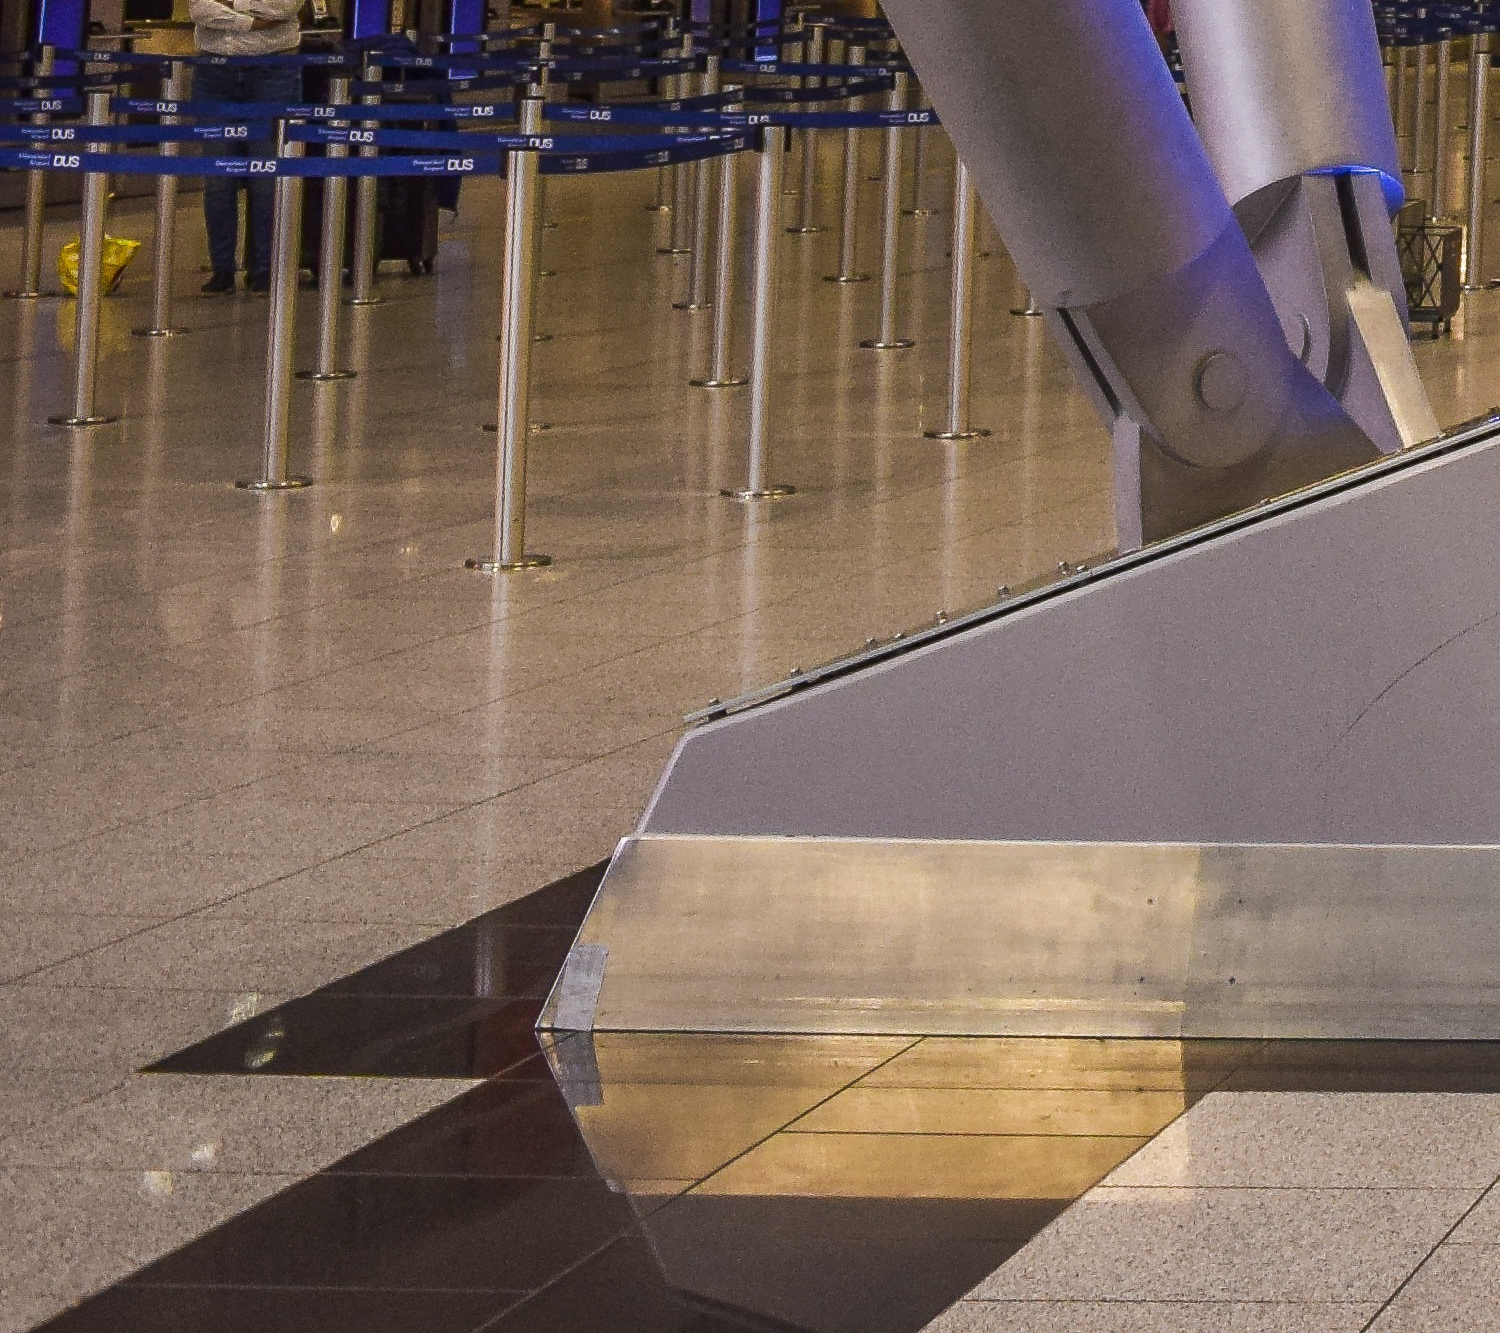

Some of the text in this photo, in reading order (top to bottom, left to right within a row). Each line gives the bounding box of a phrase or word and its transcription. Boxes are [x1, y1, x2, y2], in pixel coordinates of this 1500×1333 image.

[41, 101, 62, 110] DUS
[156, 102, 177, 112] DUS
[472, 106, 494, 116] DUS
[314, 107, 336, 117] DUS
[590, 111, 612, 121] DUS
[52, 128, 75, 140] DUS
[224, 126, 248, 138] DUS
[350, 131, 374, 143] DUS
[53, 155, 80, 168] DUS
[250, 160, 277, 173] DUS
[448, 159, 474, 172] DUS
